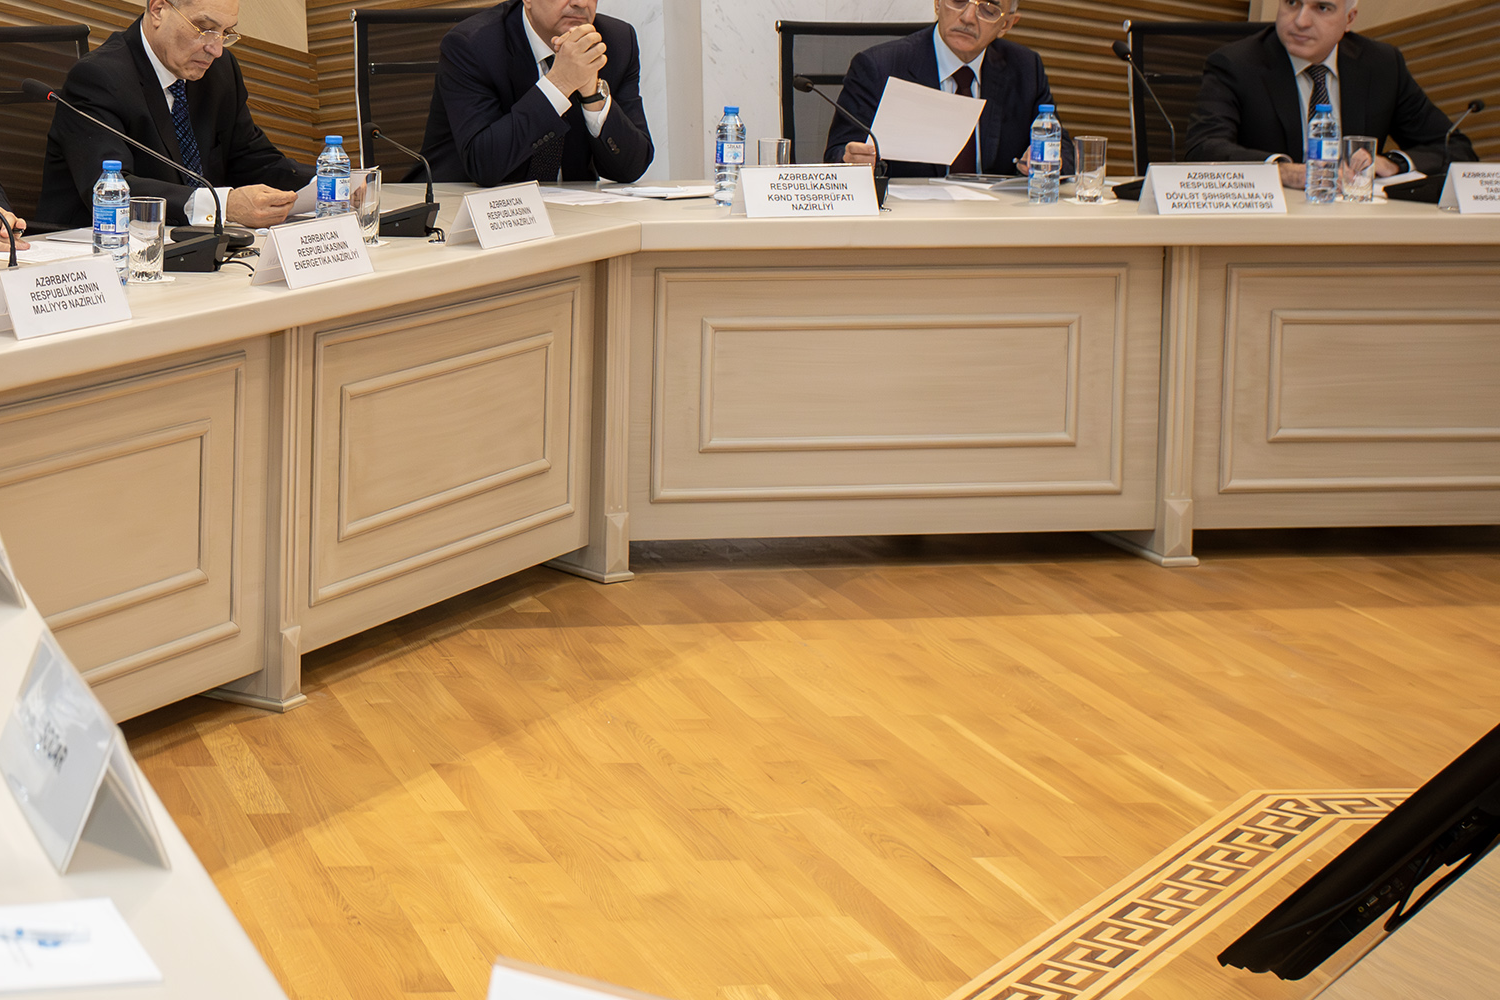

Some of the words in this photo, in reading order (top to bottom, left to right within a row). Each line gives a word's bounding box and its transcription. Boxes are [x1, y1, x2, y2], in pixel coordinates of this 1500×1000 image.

[778, 173, 838, 181] AZƏRBAYCAN
[1186, 172, 1244, 180] AZƏRBAYCAN
[770, 181, 848, 190] RESPUBLİKASININ
[1179, 180, 1255, 189] RESPUBLİKASININ
[768, 194, 792, 202] KƏND
[794, 193, 854, 202] TƏSƏRRÜFATI
[1166, 191, 1200, 200] DÖVLƏT
[1202, 192, 1260, 202] ŞƏHƏRSALMA
[1263, 192, 1274, 200] VƏ
[489, 198, 523, 209] AZƏRBAYCAN
[792, 202, 834, 211] NAZİRLİYİ
[1172, 200, 1230, 209] ARXİTEKTURA
[1232, 200, 1273, 208] KOMİTƏSİ
[487, 207, 531, 220] RESPUBLİKASININ
[513, 216, 536, 226] NAZİRLİYİ
[300, 231, 339, 244] AZƏRBAYCAN
[297, 241, 348, 257] RESPUBLİKASININ
[294, 254, 332, 270] ENERGETİKA
[333, 248, 359, 262] NAZİRLİYİ
[36, 271, 88, 288] AZƏRBAYCAN
[30, 282, 100, 302] RESPUBLİKASININ
[32, 301, 68, 315] MALİYYƏ
[70, 292, 106, 308] NAZİRLİYİ
